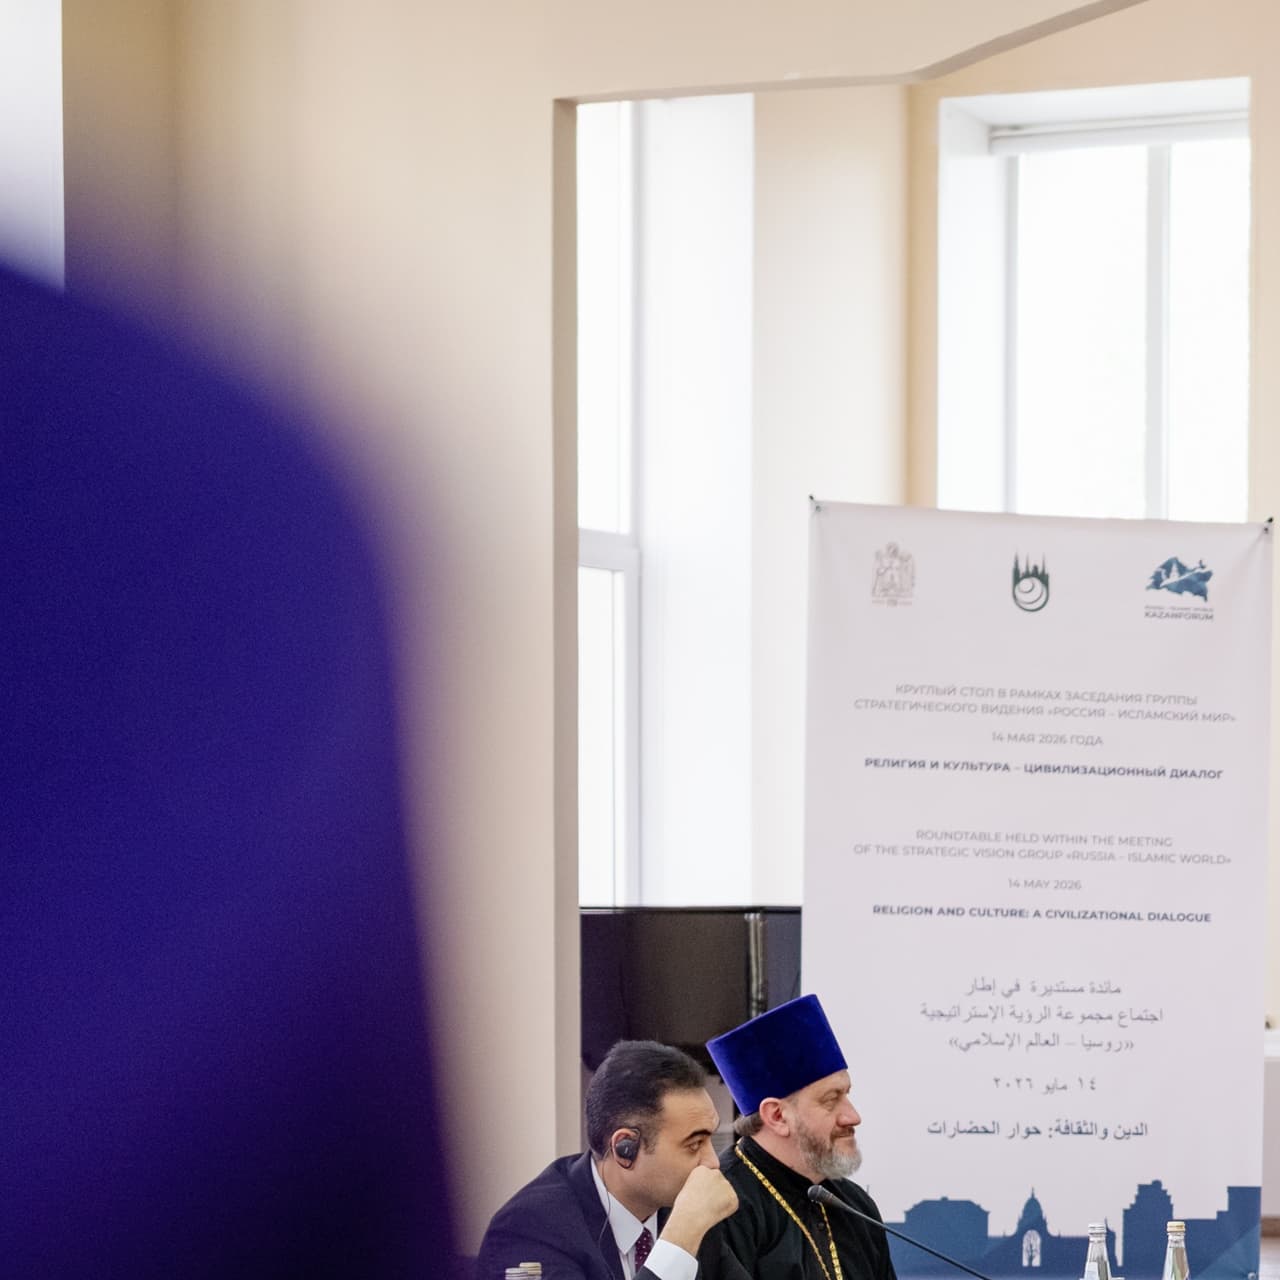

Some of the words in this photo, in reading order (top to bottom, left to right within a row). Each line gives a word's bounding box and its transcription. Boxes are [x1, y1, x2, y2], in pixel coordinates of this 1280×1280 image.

[896, 684, 957, 696] КРУГЛЫЙ
[960, 686, 994, 697] СТОЛ
[998, 688, 1006, 699] В
[1009, 689, 1061, 700] РАМКАХ
[1065, 691, 1142, 704] ЗАСЕДАНИЯ
[1146, 694, 1197, 706] ГРУППЫ
[992, 732, 1004, 741] 14
[1007, 733, 1035, 743] МАЯ
[1039, 734, 1067, 744] 2026
[1070, 735, 1104, 746] ГОДА
[865, 758, 926, 768] РЕЛИГИЯ
[944, 761, 1010, 772] КУЛЬТУРА
[1024, 764, 1166, 777] ЦИВИЛИЗАЦИОННЫЙ
[1170, 769, 1222, 779] ДИАЛОГ
[916, 830, 1001, 842] ROUNDTABLE
[1005, 833, 1039, 843] HELD
[1042, 834, 1088, 845] WITHIN
[1092, 835, 1114, 846] THE
[1118, 836, 1172, 847] MEETING
[853, 844, 871, 854] OF
[875, 844, 898, 856] THE
[902, 845, 969, 857] STRATEGIC
[973, 848, 1015, 858] VISION
[1018, 849, 1063, 860] GROUP
[1066, 850, 1116, 861] «RUSSIA
[1128, 853, 1176, 864] ISLAMIC
[1179, 854, 1231, 864] WORLD»
[1008, 879, 1020, 888] 14
[1024, 880, 1050, 888] MAY
[1054, 879, 1082, 890] 2026
[873, 905, 933, 915] RELIGION
[937, 907, 965, 917] AND
[969, 908, 1028, 918] CULTURE:
[1033, 909, 1041, 918] A
[1045, 910, 1143, 921] CIVILIZATIONAL
[1148, 912, 1210, 922] DIALOGUE
[928, 1121, 999, 1138] الحضارات
[1008, 1124, 1041, 1140] حوار
[1049, 1120, 1108, 1140] والثقافة:
[1114, 1122, 1147, 1140] الدين
